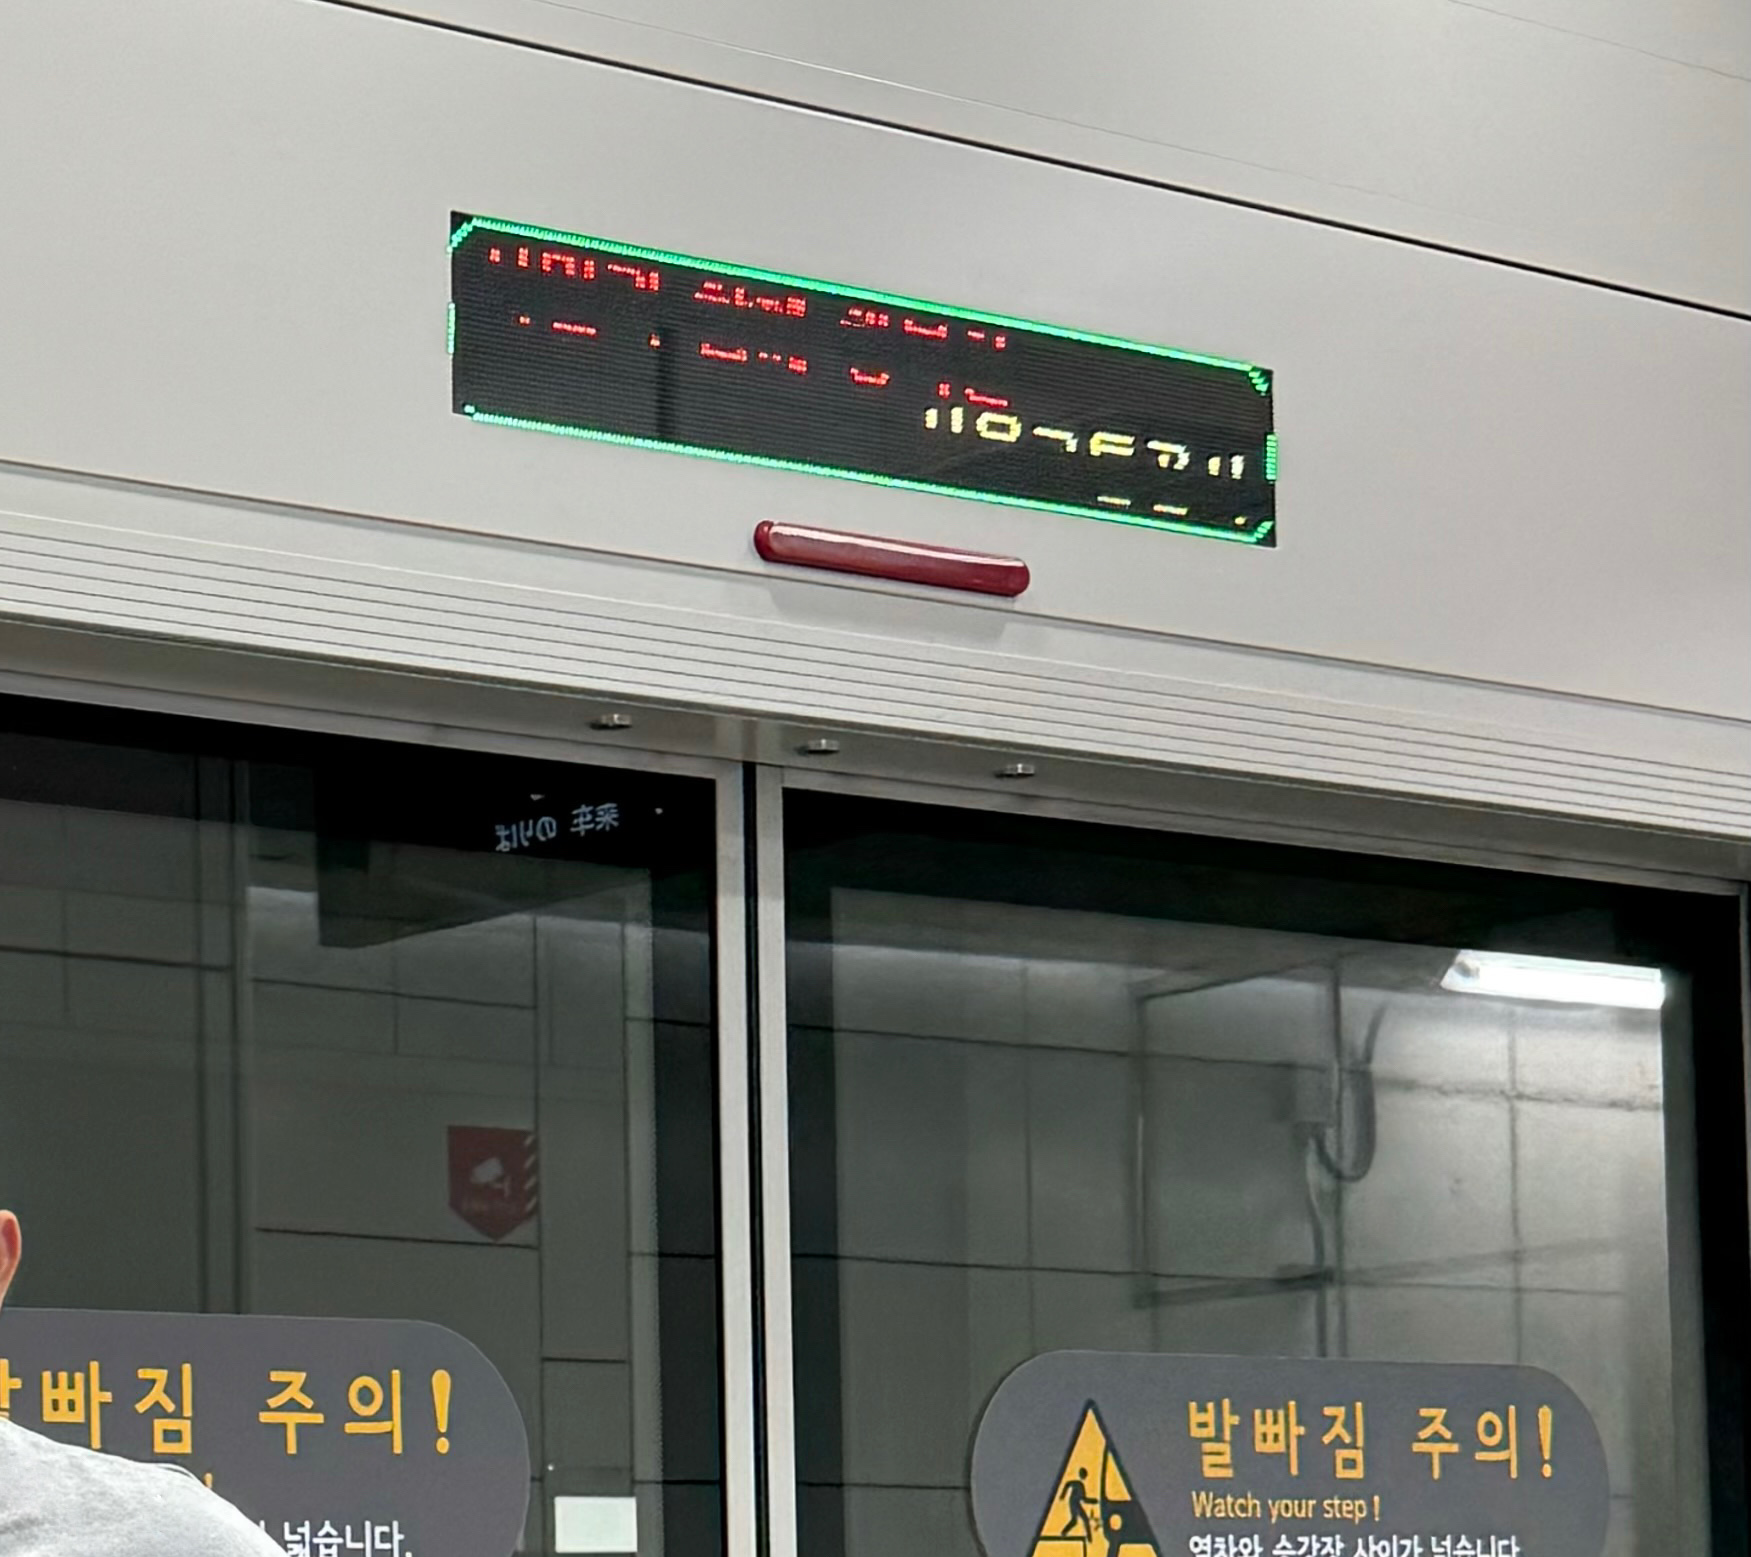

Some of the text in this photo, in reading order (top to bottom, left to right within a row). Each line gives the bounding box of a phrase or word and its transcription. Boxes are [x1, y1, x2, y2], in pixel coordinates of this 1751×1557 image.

[1188, 1399, 1365, 1480] 발빠짐
[1191, 1490, 1261, 1519] Watch
[1267, 1498, 1317, 1524] your
